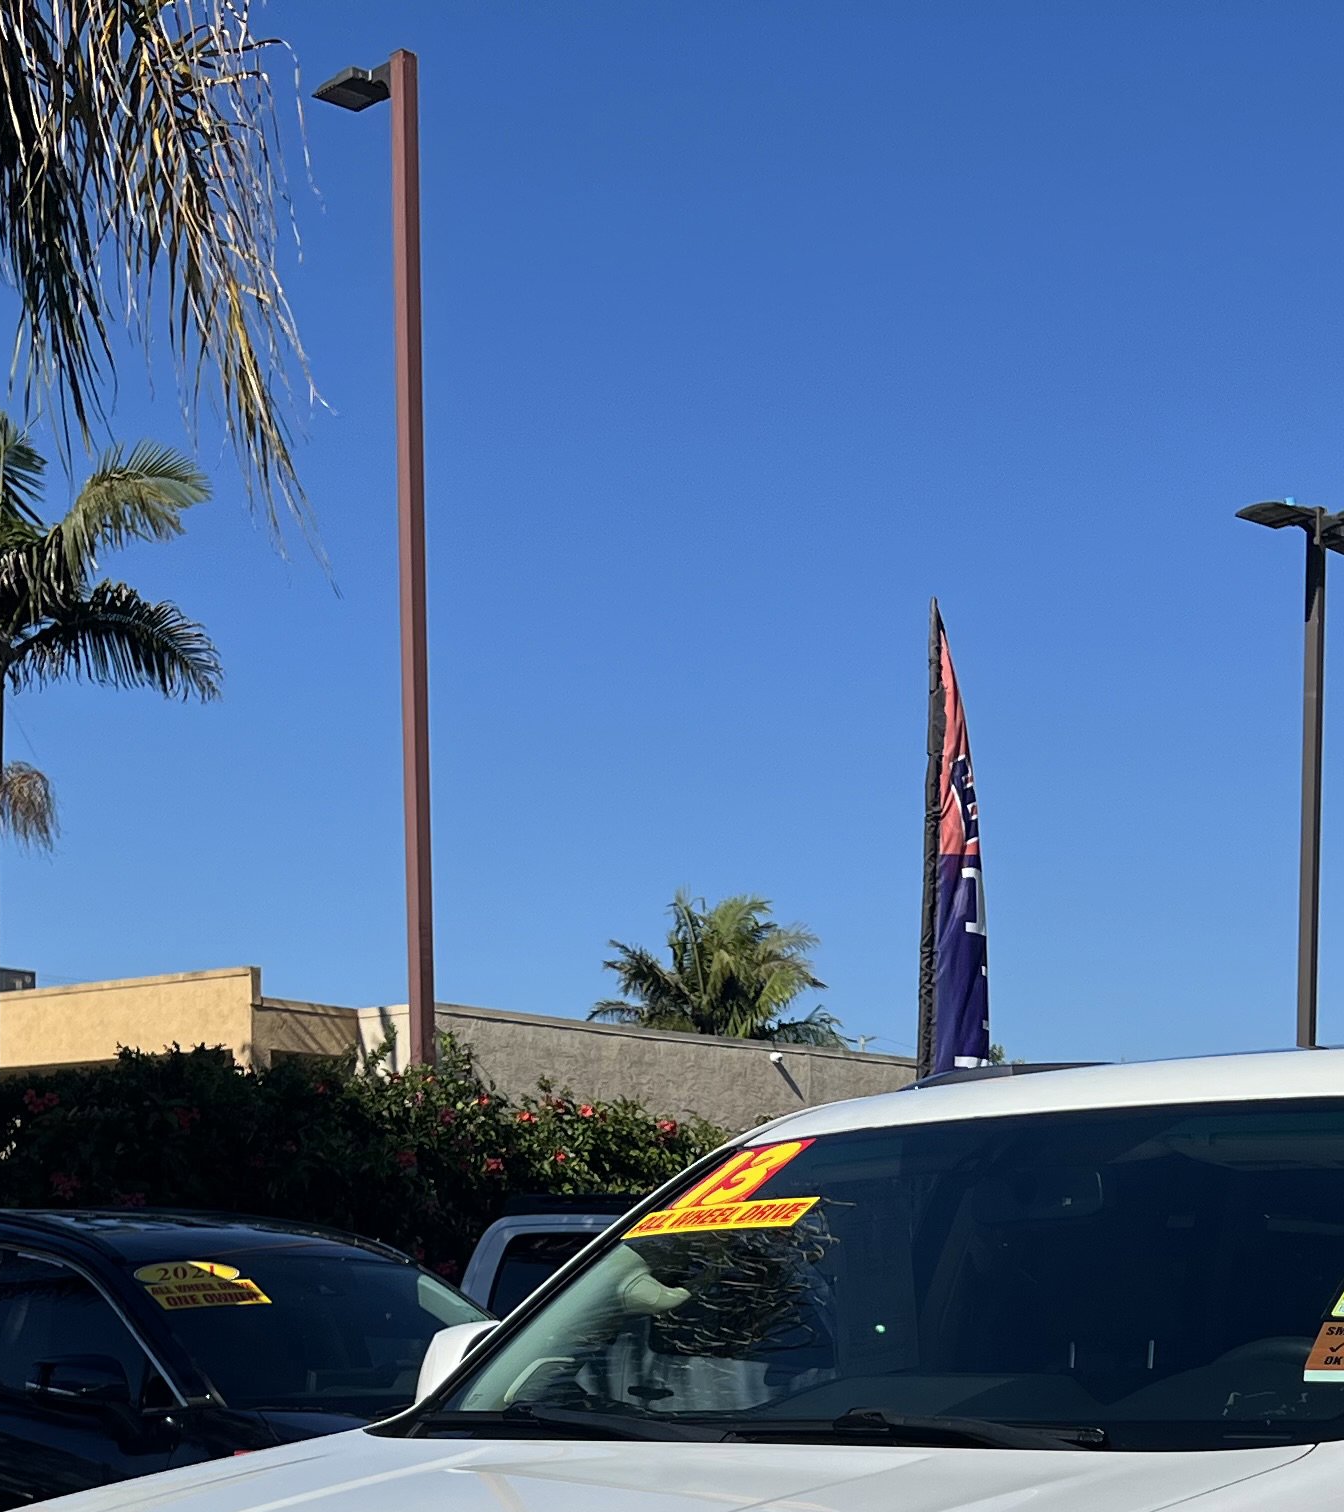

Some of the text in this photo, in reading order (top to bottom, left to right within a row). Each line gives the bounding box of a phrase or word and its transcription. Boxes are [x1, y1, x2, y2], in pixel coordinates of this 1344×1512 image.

[672, 1141, 803, 1209] 13
[670, 1207, 741, 1228] WHEEL
[736, 1203, 809, 1223] DRIVE
[165, 1294, 201, 1306] ONE
[1323, 1356, 1344, 1366] OK
